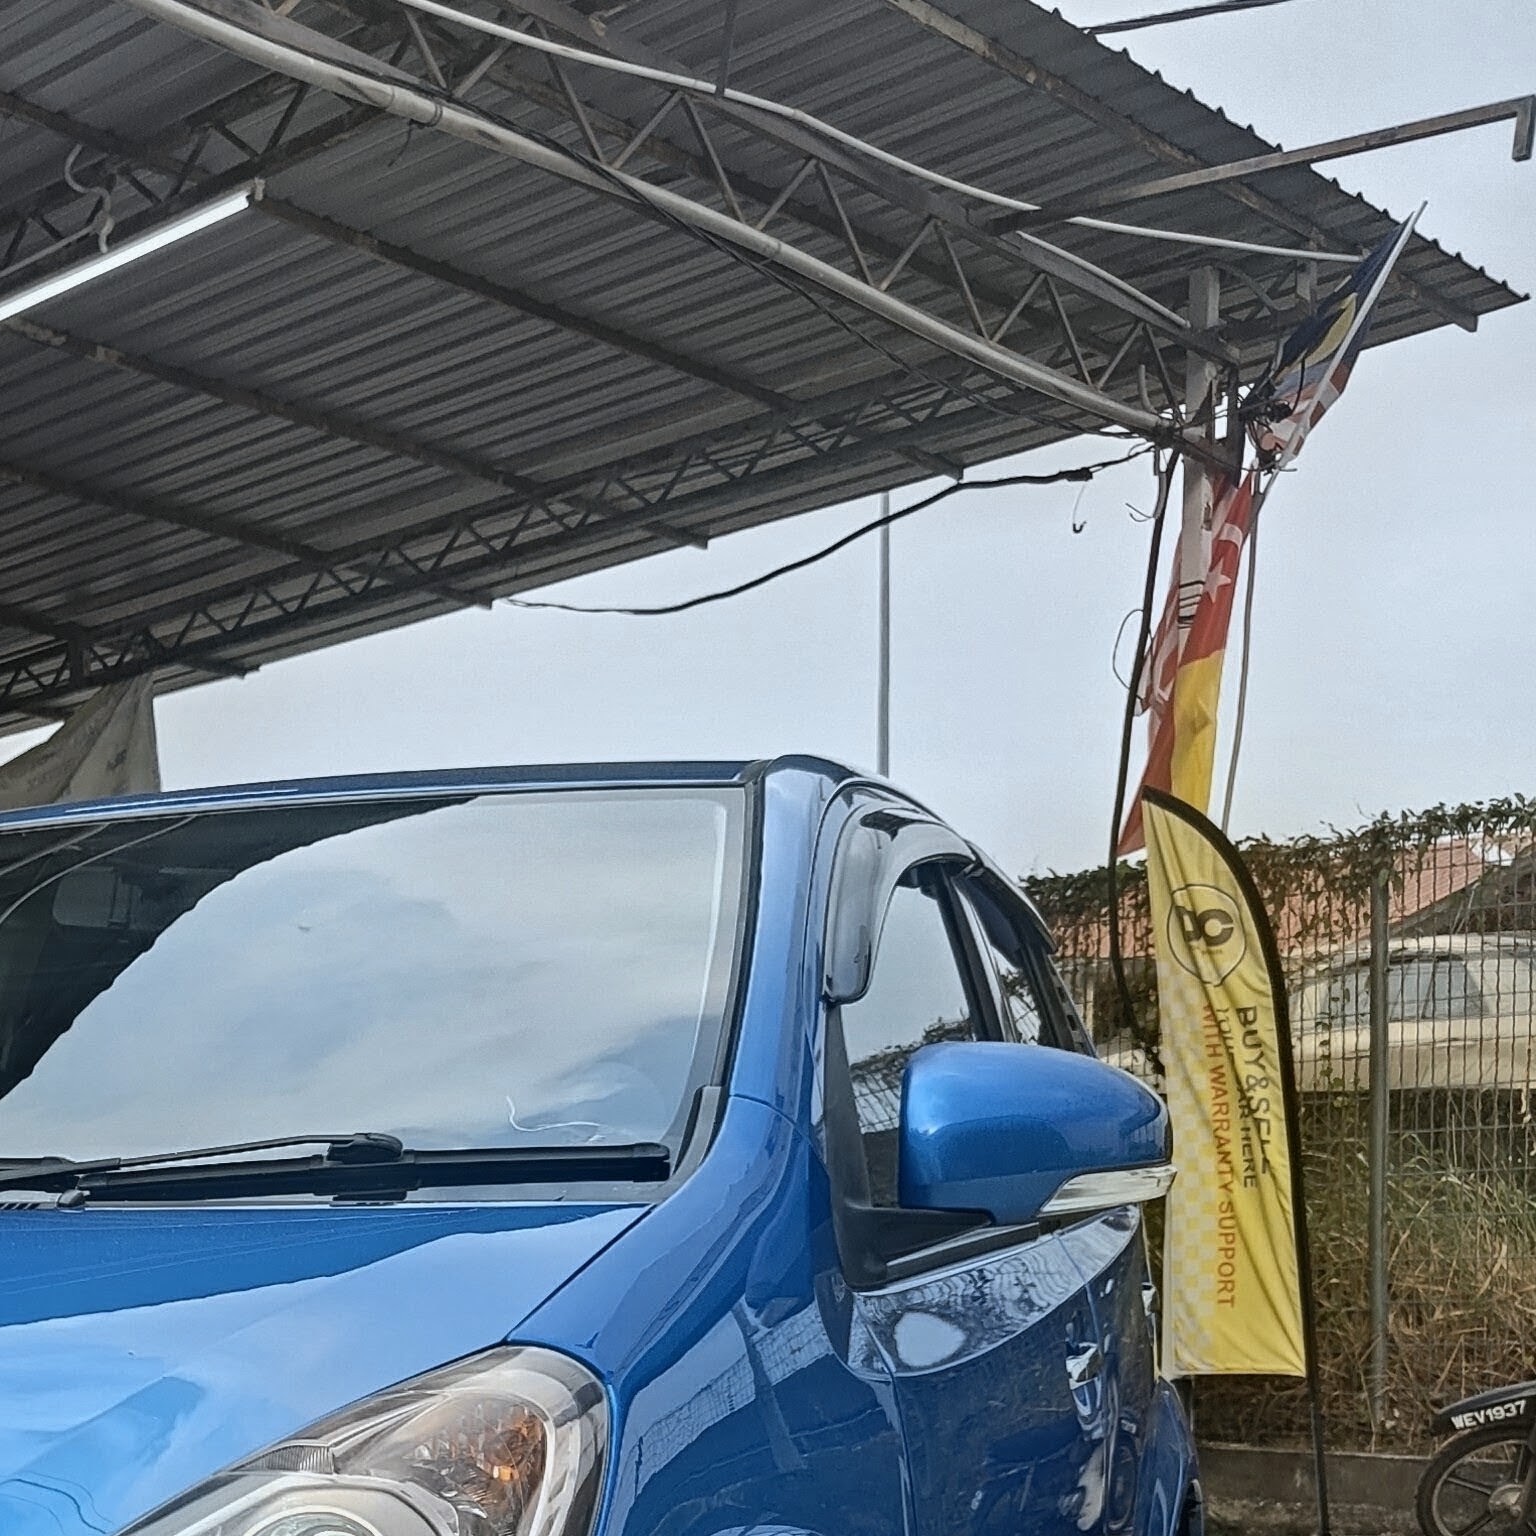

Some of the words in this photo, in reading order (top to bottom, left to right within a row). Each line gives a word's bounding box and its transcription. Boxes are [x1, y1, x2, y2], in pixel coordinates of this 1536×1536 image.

[1175, 905, 1234, 947] DC
[1202, 1003, 1224, 1058] WITH
[1209, 1064, 1234, 1194] WARRANTY
[1216, 1200, 1237, 1308] SUPPORT
[1450, 1400, 1527, 1430] WEV1937
